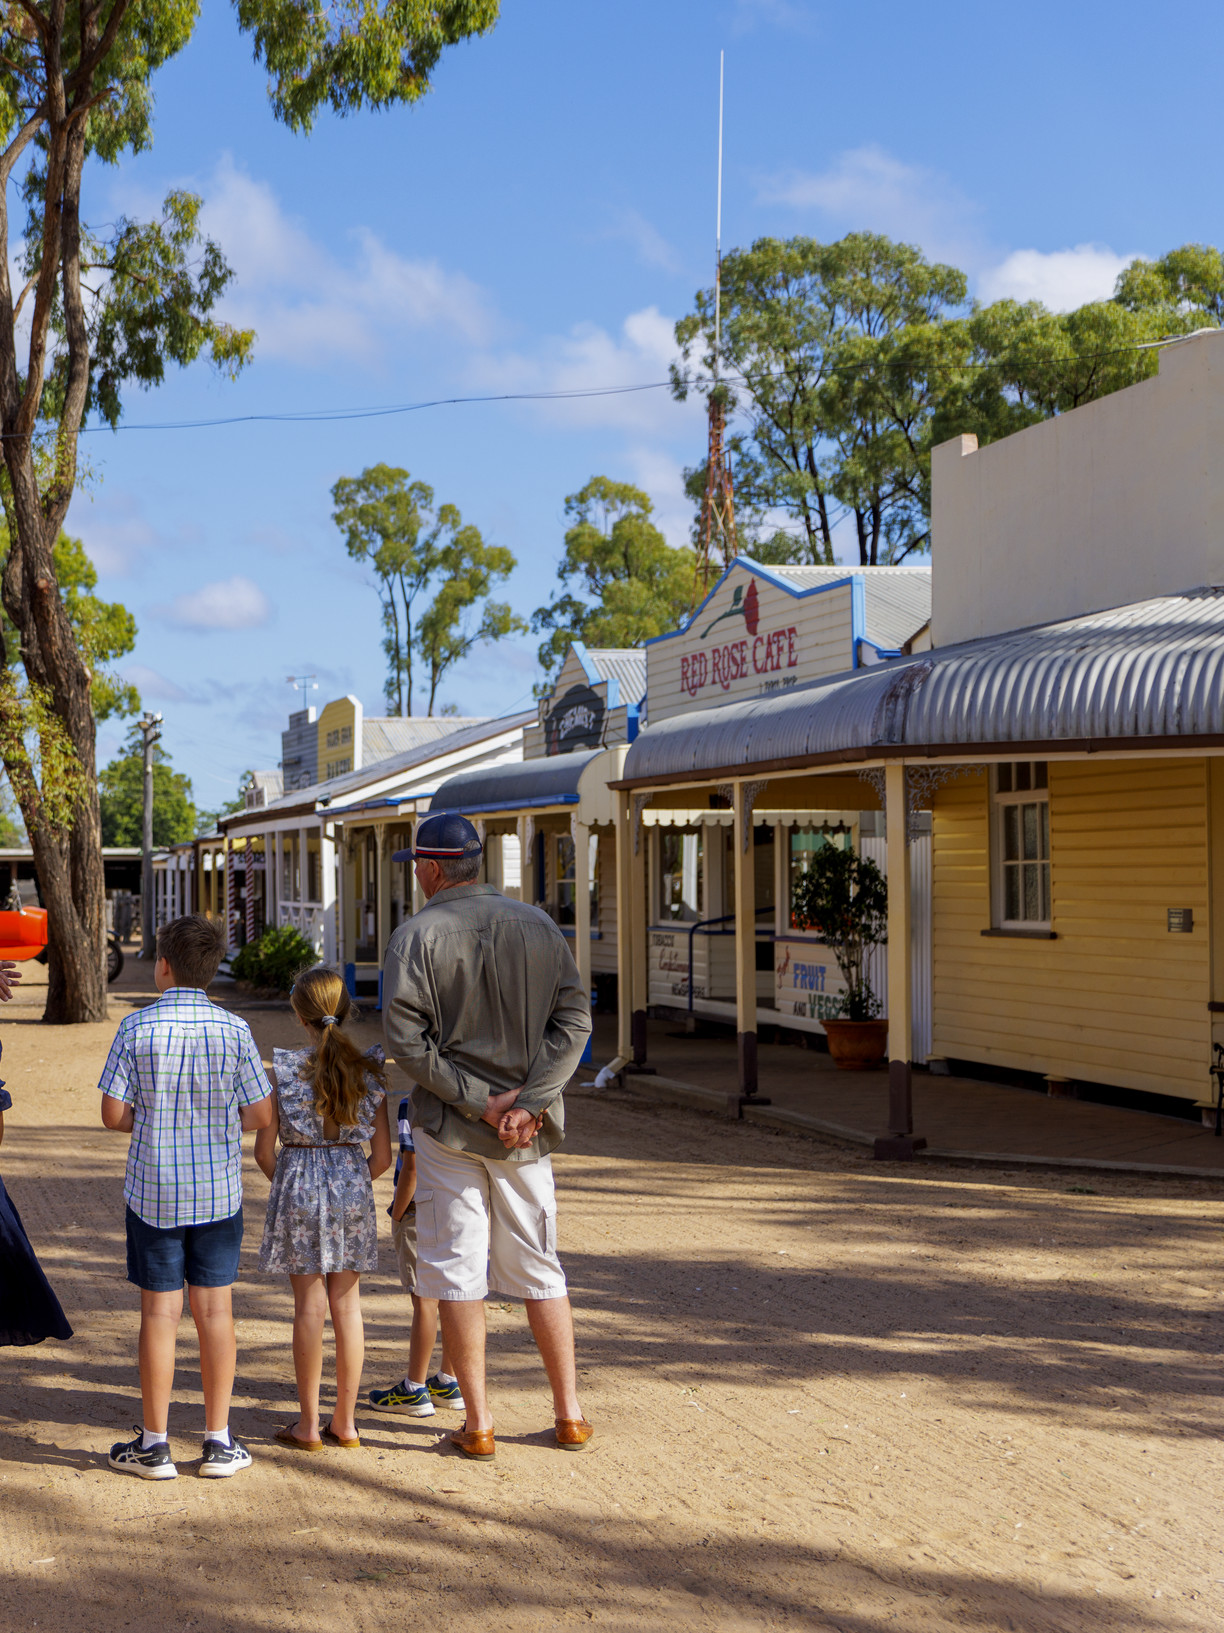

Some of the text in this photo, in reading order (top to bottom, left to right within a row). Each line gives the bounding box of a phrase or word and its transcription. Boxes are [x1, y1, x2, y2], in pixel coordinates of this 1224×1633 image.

[680, 627, 798, 697] RED ROSE CAFE
[793, 963, 826, 992] FRUIT
